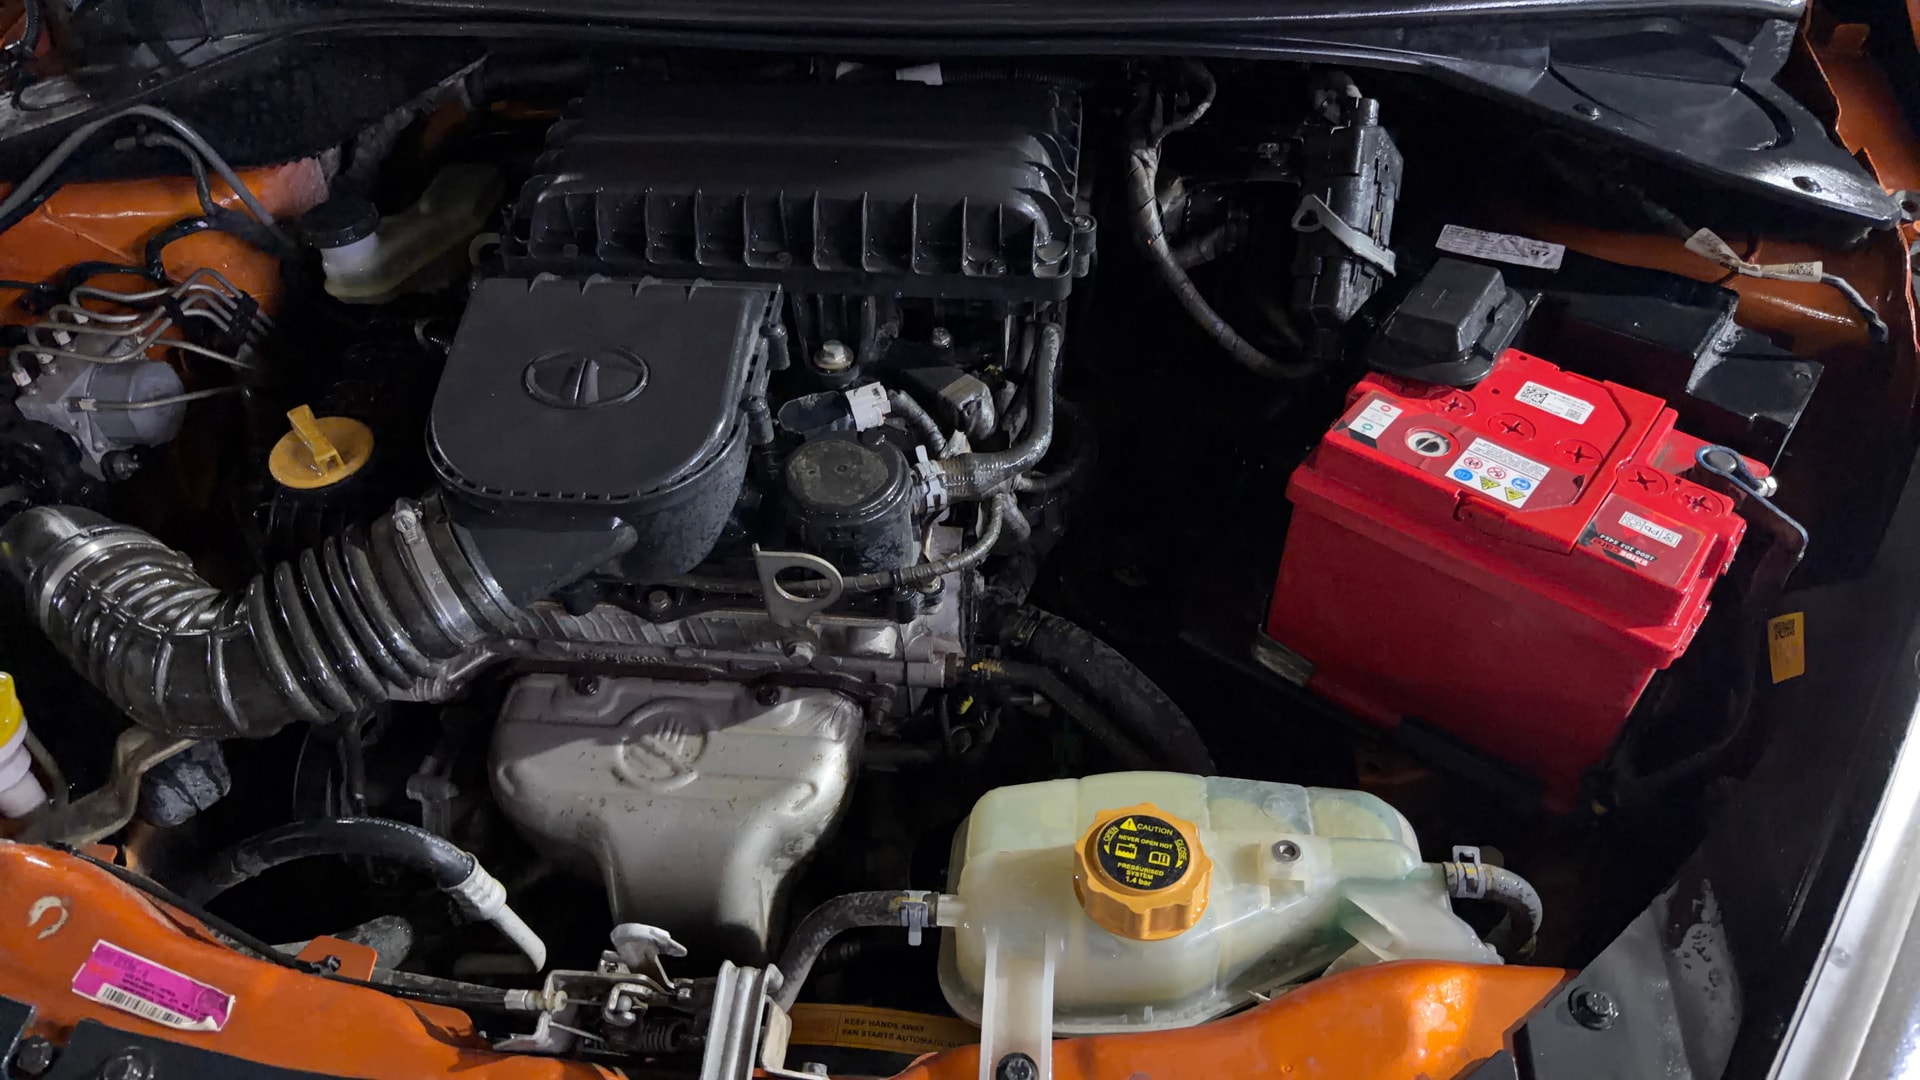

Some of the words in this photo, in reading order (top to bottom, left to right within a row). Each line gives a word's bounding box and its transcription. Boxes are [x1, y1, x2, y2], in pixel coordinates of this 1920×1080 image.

[1644, 524, 1660, 537] Pb
[1635, 550, 1655, 561] 1800
[1103, 825, 1120, 842] OPEN
[1137, 823, 1173, 836] CAUTION
[1118, 834, 1140, 844] NEVER
[1140, 838, 1159, 847] OPEN
[1159, 842, 1173, 850] HOT
[1174, 838, 1188, 861] CLOSE
[1117, 862, 1165, 877] PRESSURISED
[1126, 869, 1154, 880] SYSTEM
[1125, 875, 1137, 884] 1.4
[1138, 878, 1152, 887] bar
[843, 1017, 867, 1026] KEEP
[868, 1018, 899, 1030] HANDS
[901, 1022, 925, 1033] AWAY
[842, 1028, 859, 1037] FAN
[861, 1030, 894, 1040] STARTS
